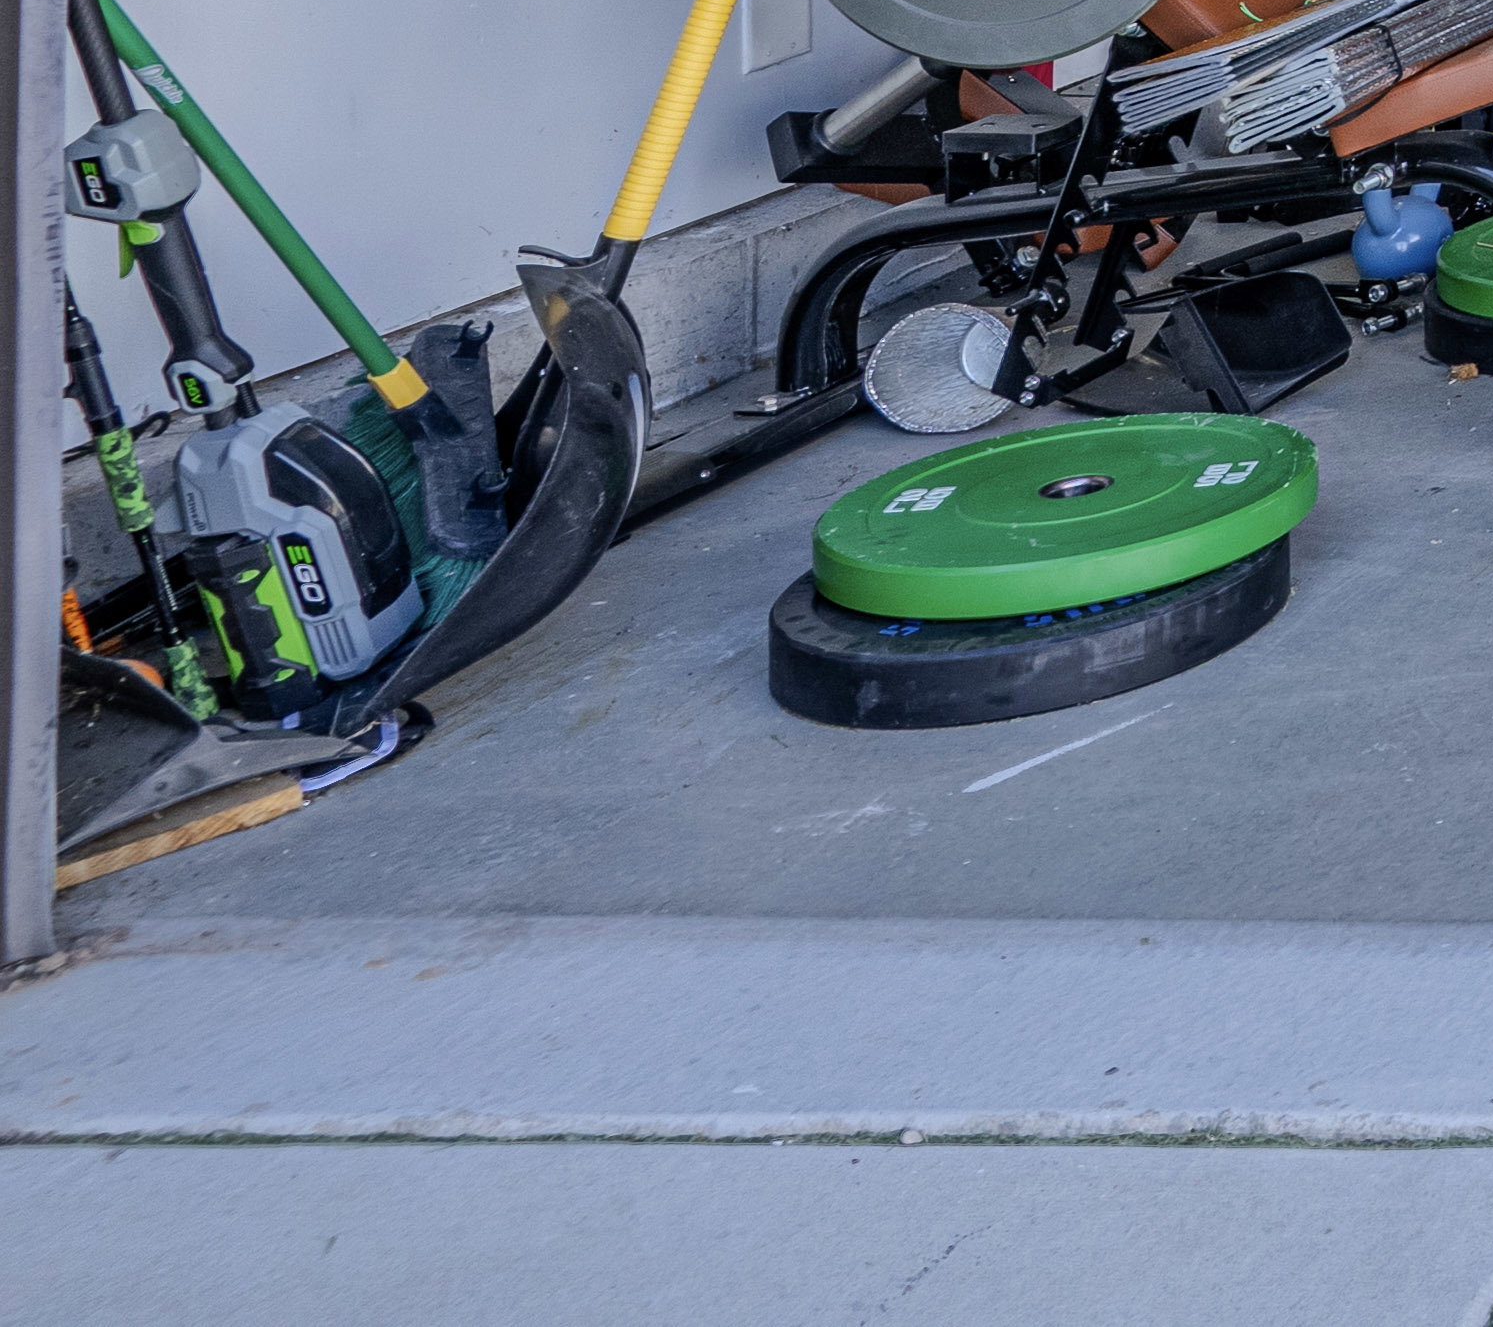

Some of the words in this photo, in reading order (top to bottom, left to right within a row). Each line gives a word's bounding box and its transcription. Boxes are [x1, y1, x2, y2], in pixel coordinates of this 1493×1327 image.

[81, 160, 108, 205] EGO
[183, 377, 204, 406] 56V
[284, 544, 325, 605] EGO
